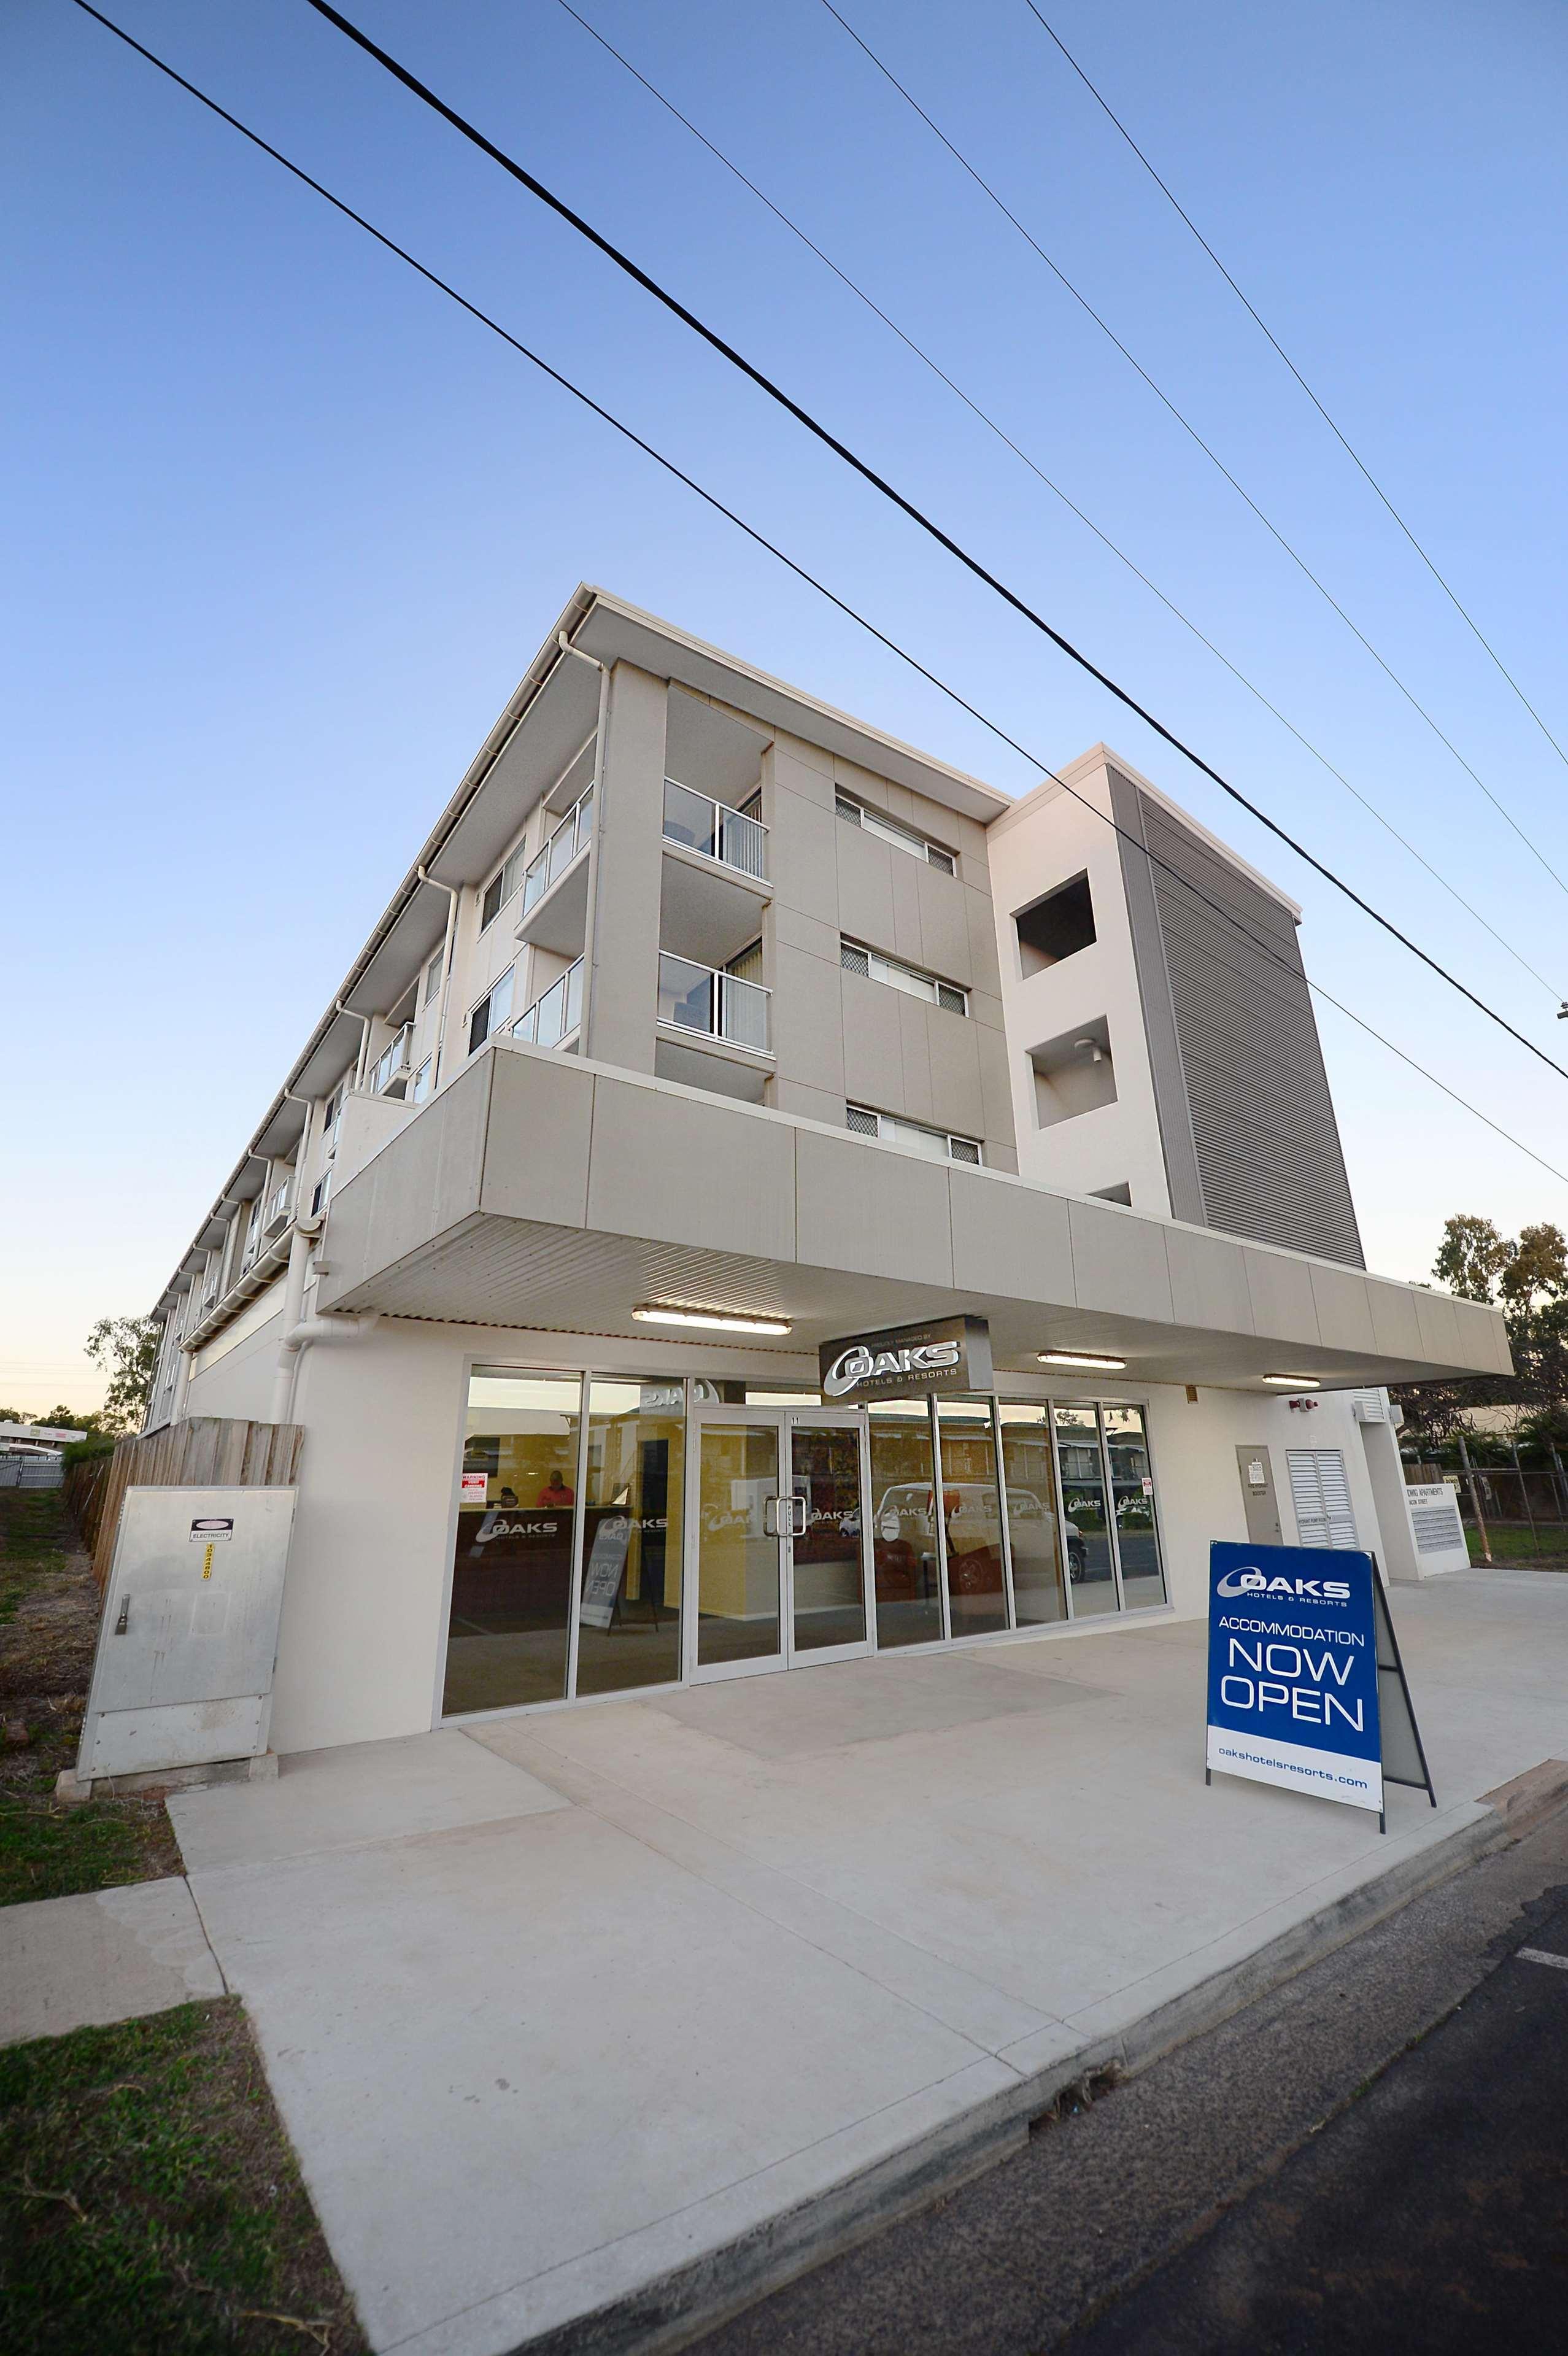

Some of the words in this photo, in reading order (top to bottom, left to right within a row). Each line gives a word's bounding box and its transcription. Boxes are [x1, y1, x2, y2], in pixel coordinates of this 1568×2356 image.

[844, 1341, 959, 1378] OAKS
[857, 1377, 892, 1388] HOTELS
[908, 1369, 957, 1380] RESORTS
[492, 1523, 558, 1535] OAKS
[811, 1510, 854, 1521] OAKS
[1240, 1574, 1350, 1599] OAKS
[1246, 1592, 1284, 1601] HOTELS
[1299, 1597, 1348, 1607] RESORTS
[1219, 1616, 1365, 1647] ACCOMMODATION
[1229, 1638, 1354, 1686] NOW
[1221, 1675, 1364, 1732] OPEN
[1219, 1748, 1368, 1790] oakshotelsresorts.com
